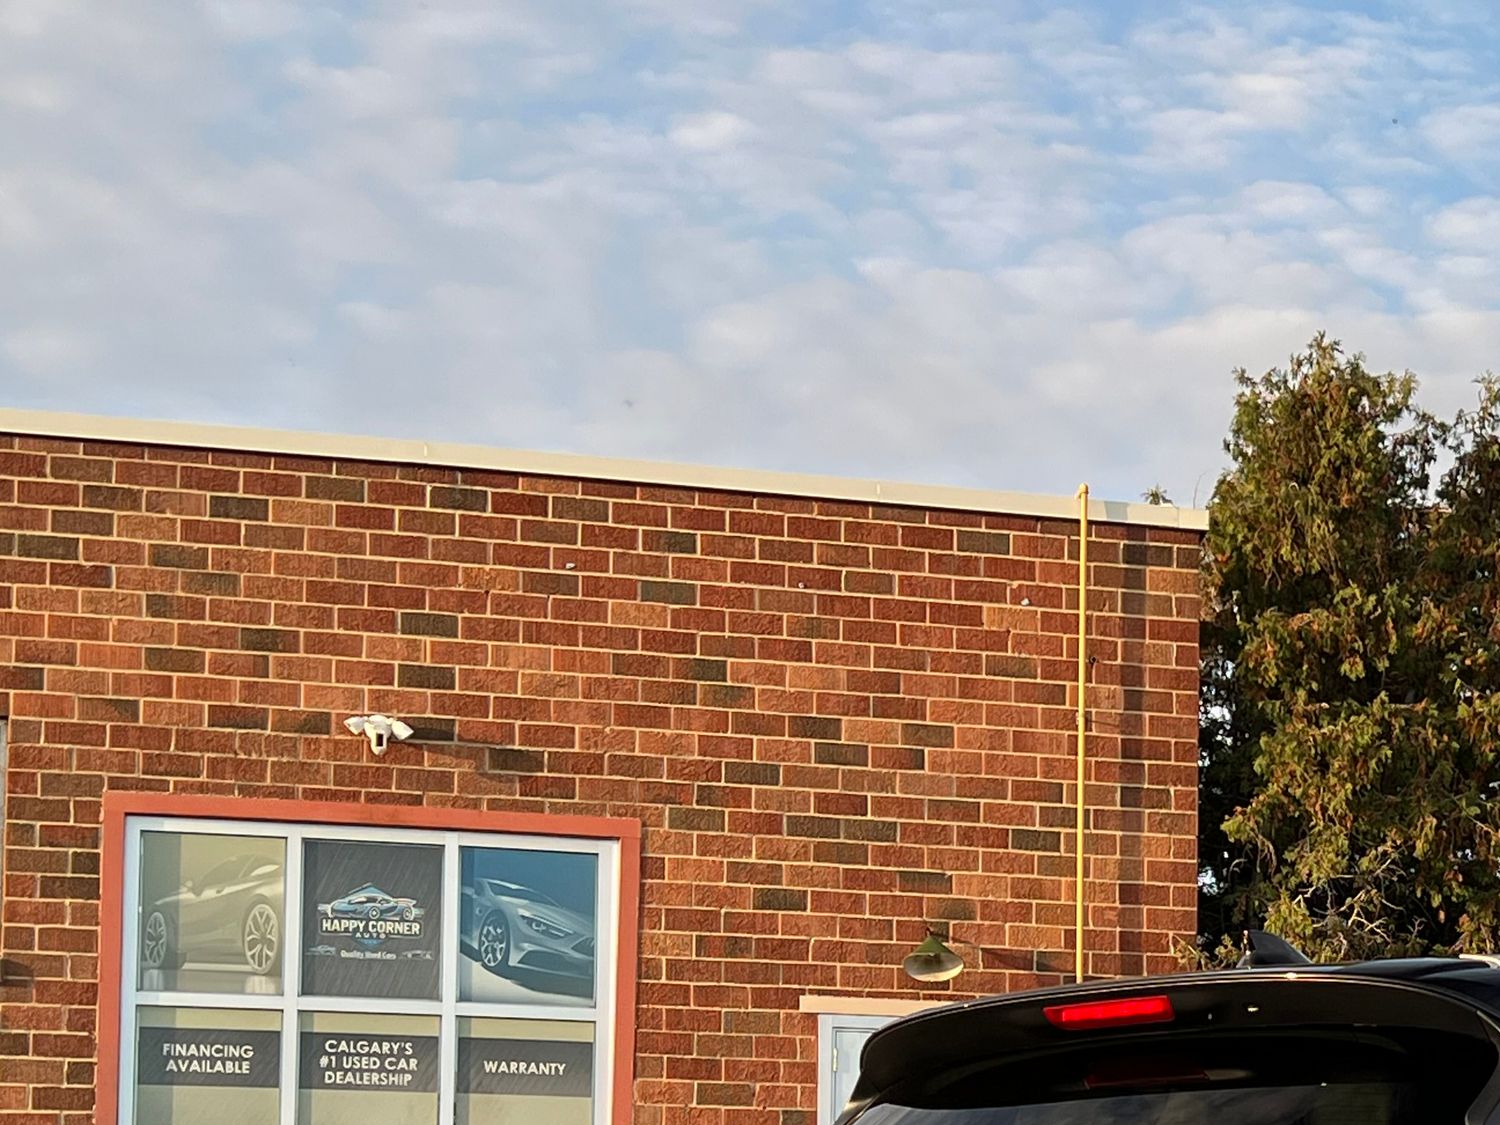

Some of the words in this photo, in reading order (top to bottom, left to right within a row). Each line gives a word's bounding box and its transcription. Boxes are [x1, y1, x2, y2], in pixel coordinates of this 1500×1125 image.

[322, 918, 366, 932] HAPPY
[368, 920, 420, 935] CORNER
[162, 1043, 254, 1058] FINANCING
[324, 1039, 413, 1055] CALGARY'S
[165, 1059, 250, 1074] AVAILABLE
[319, 1055, 336, 1068] #1
[342, 1056, 380, 1069] USED
[384, 1057, 418, 1071] CAR
[483, 1060, 566, 1075] WARRANTY
[324, 1071, 412, 1086] DEALERSHIP
